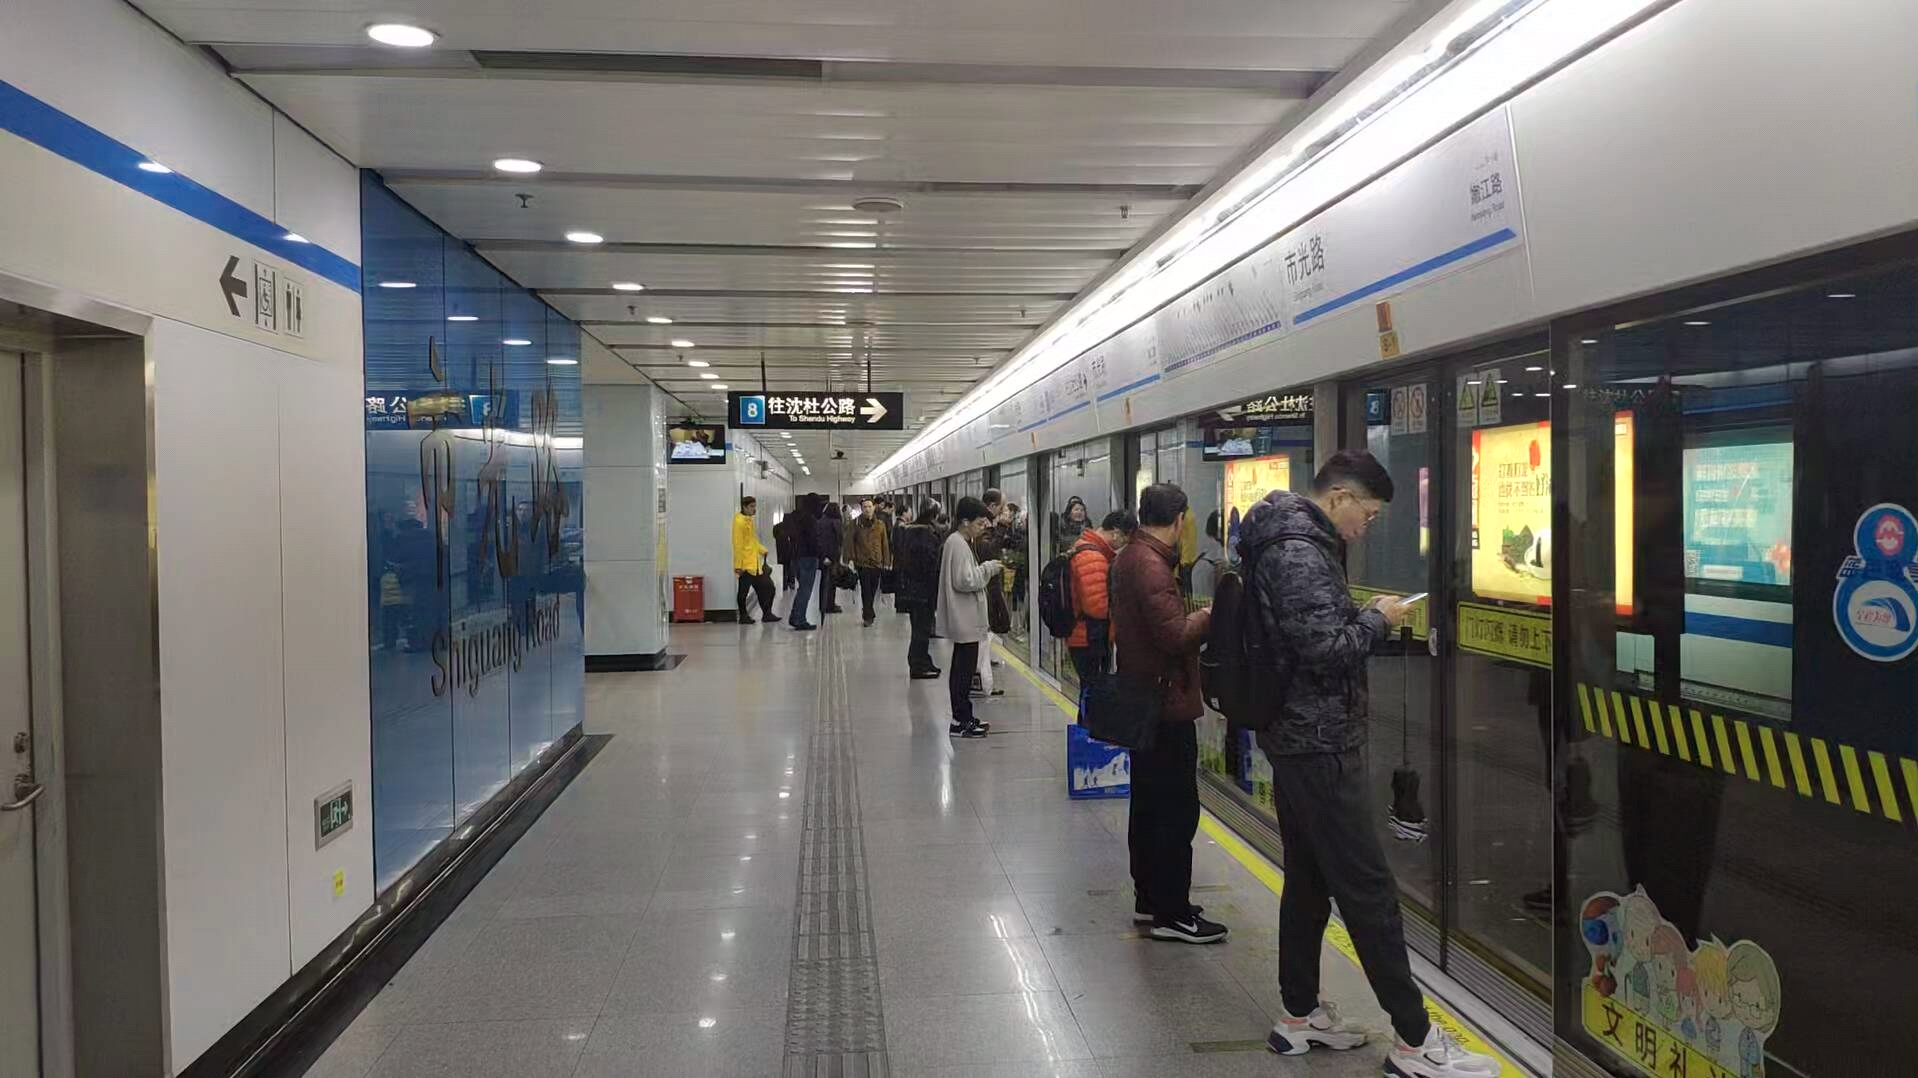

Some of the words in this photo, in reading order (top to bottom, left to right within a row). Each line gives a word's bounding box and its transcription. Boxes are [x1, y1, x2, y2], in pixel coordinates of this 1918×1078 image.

[1284, 232, 1325, 286] 市光路
[747, 402, 758, 417] 8
[768, 396, 856, 415] 往沈杜公路
[789, 414, 798, 422] To
[827, 414, 856, 424] Highway
[406, 335, 571, 593] 市光路
[431, 618, 523, 698] Shiguang
[525, 588, 561, 653] Road
[1602, 1003, 1727, 1078] 文明礼
